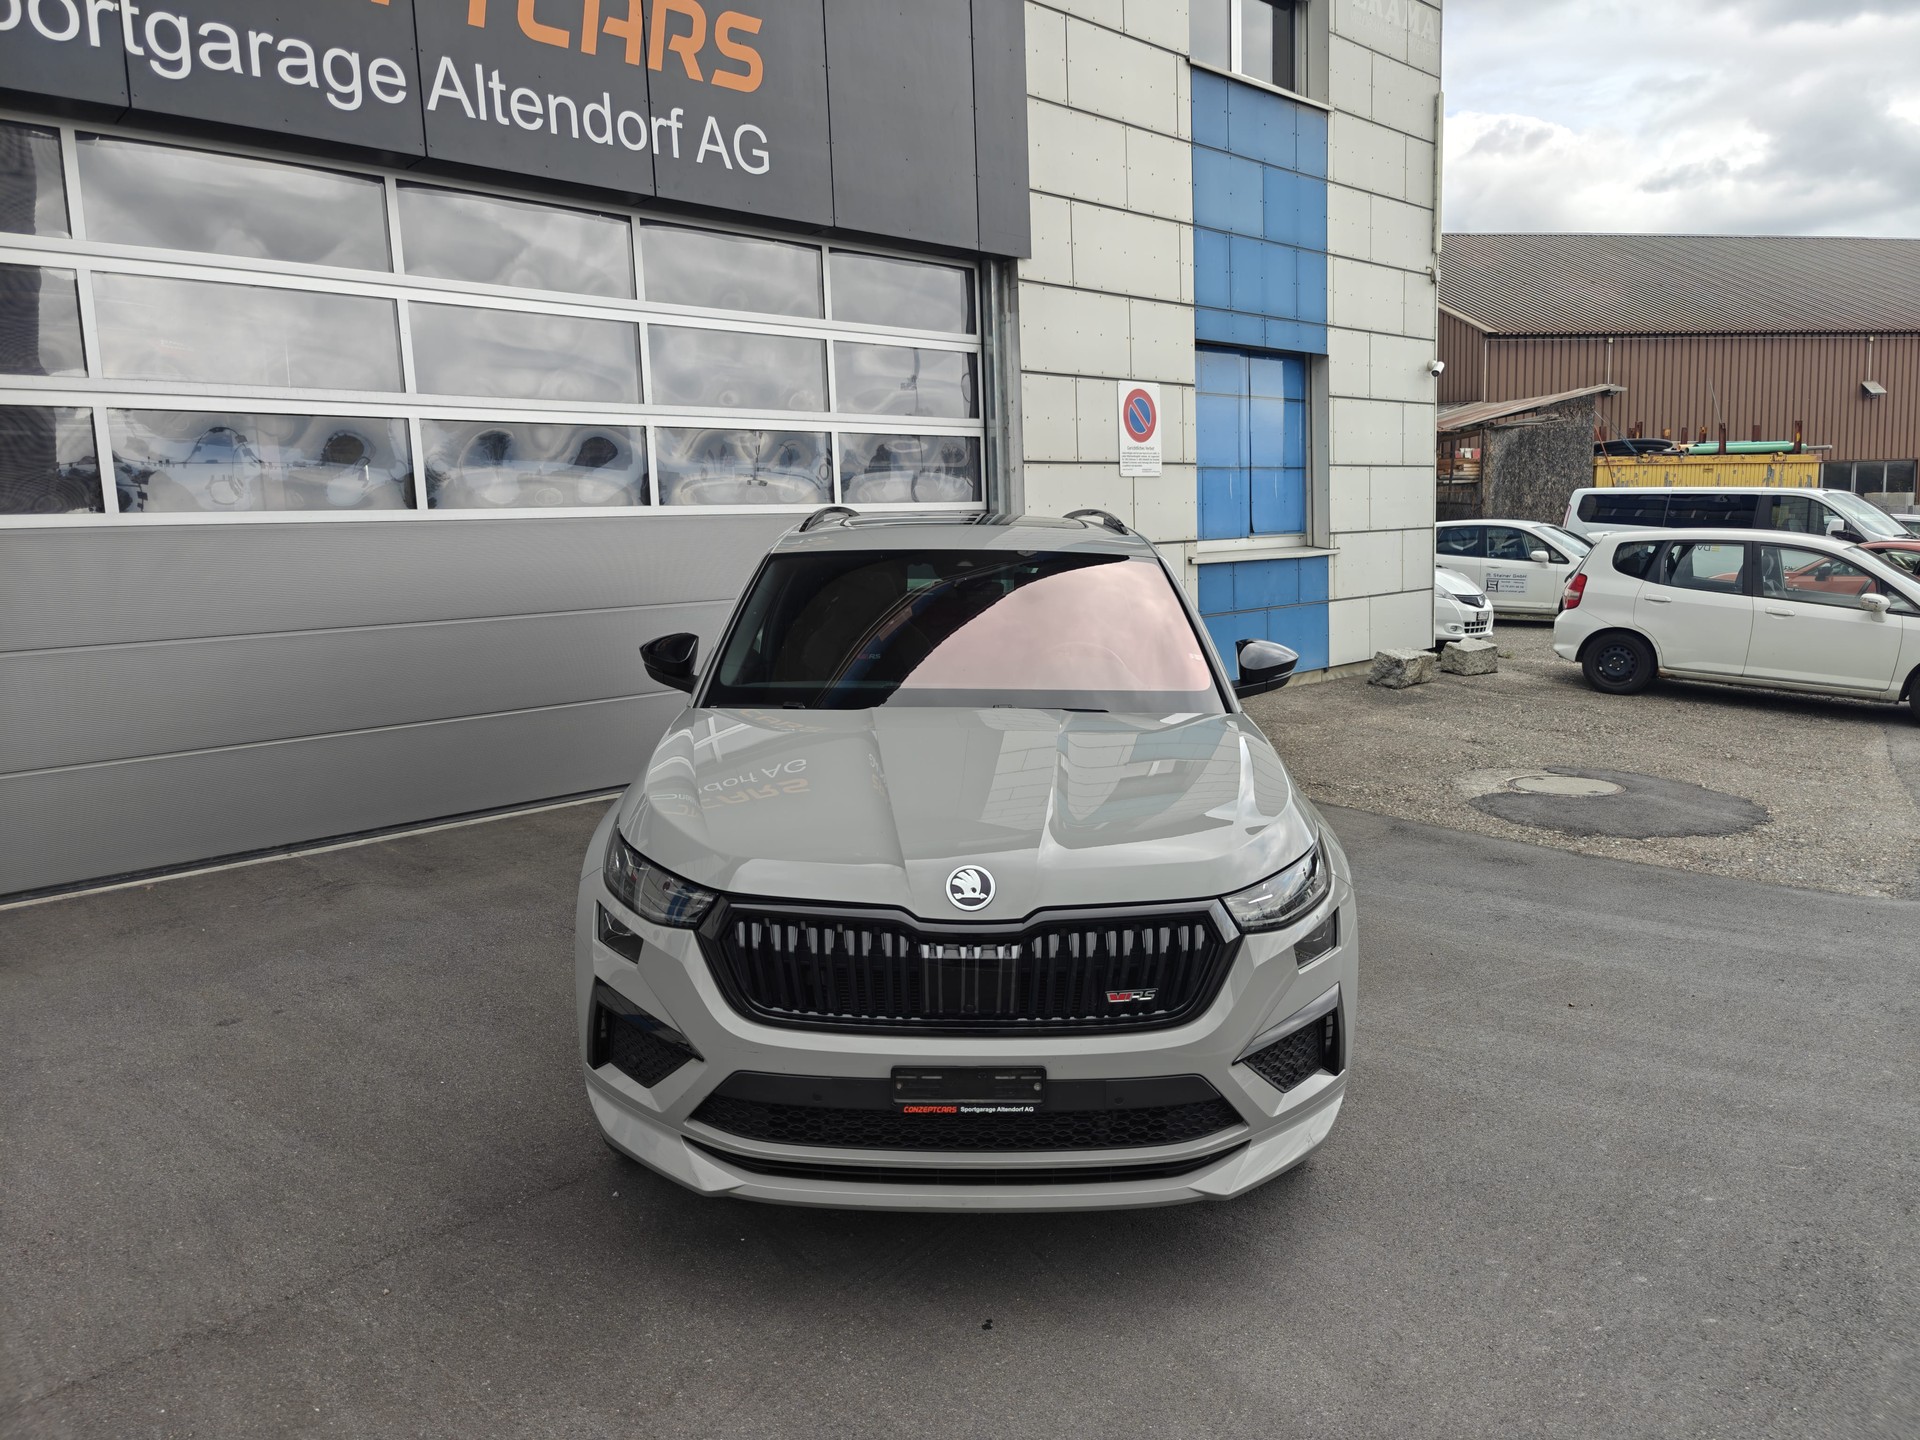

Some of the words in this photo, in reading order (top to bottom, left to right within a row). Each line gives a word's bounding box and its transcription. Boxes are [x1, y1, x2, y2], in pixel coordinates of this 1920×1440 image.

[371, 0, 764, 93] CARS
[427, 56, 684, 159] Altendorf
[696, 116, 770, 175] AG
[960, 1106, 996, 1114] Sportgarage
